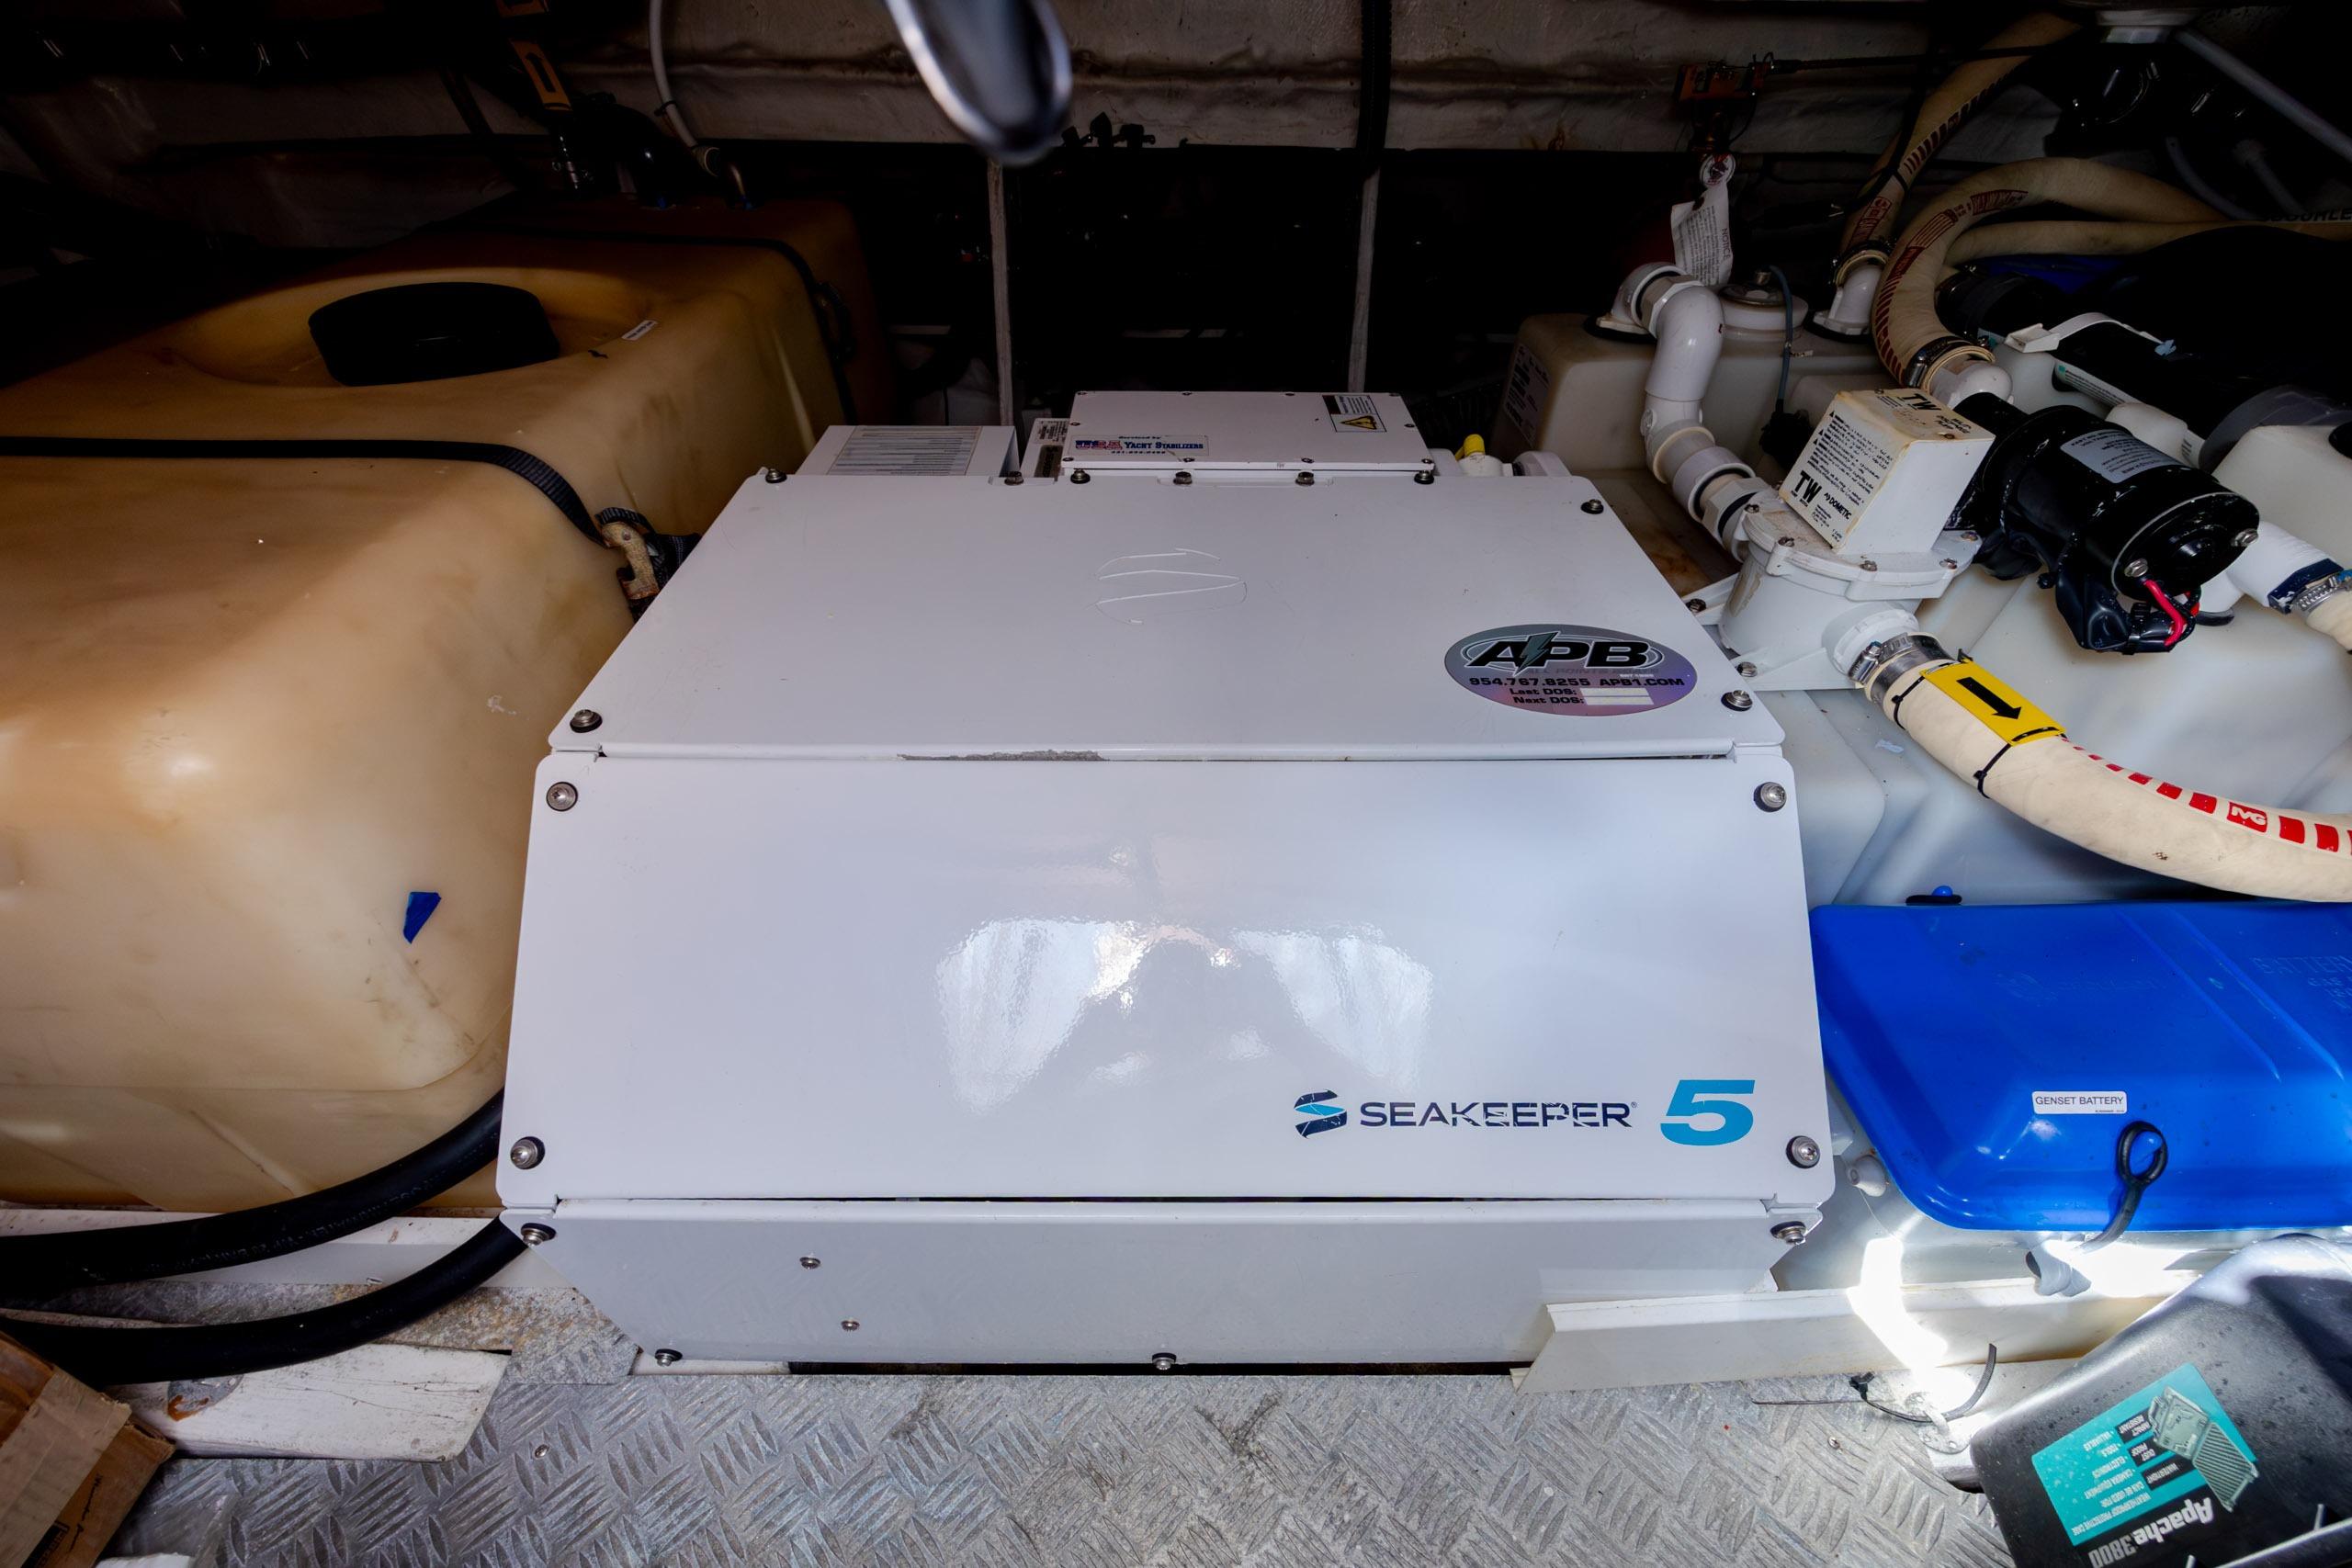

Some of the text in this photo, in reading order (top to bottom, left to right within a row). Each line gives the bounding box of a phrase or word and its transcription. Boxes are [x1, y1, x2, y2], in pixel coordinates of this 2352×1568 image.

[1720, 228, 1731, 259] NOTICE
[1902, 393, 1941, 411] TW
[1795, 470, 1823, 503] TW
[1827, 496, 1852, 521] DOMETIC
[1468, 640, 1651, 668] APB
[1469, 677, 1685, 687] 954.767.8255 APB1.COM
[1513, 696, 1585, 705] Next DOS:
[2035, 1096, 2123, 1105] GENSET BATTERY
[1659, 1079, 1756, 1146] 5
[2120, 1415, 2144, 1434] RESISTANT
[2084, 1432, 2111, 1450] VALUABLES
[2131, 1443, 2147, 1457] PROOF
[2101, 1444, 2119, 1457] TOOLS
[2142, 1449, 2155, 1461] DUST
[2092, 1457, 2124, 1478] ELECTRONICS
[2110, 1469, 2132, 1485] CAMERA
[2088, 1497, 2213, 1568] Apache 3800
